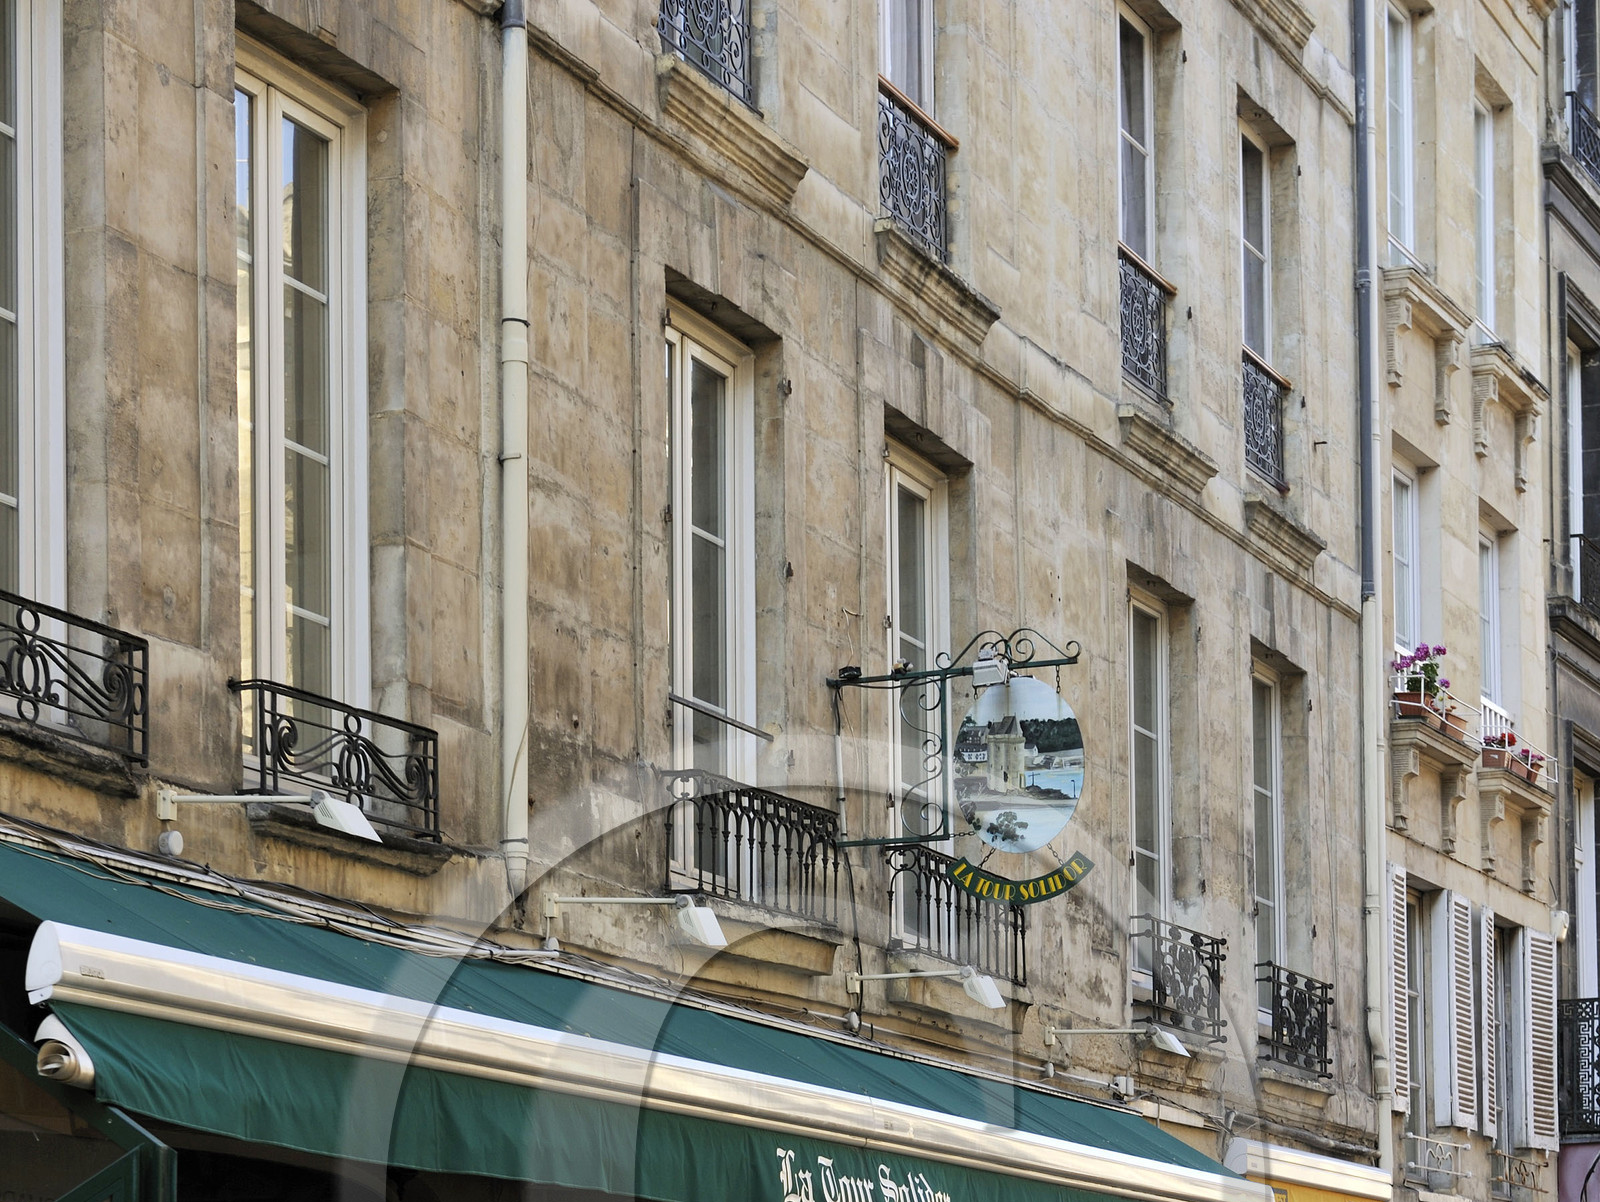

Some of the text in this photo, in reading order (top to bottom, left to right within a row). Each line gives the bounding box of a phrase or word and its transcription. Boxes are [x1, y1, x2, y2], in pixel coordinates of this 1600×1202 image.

[953, 858, 1088, 901] LA TOUR SOLIDOR
